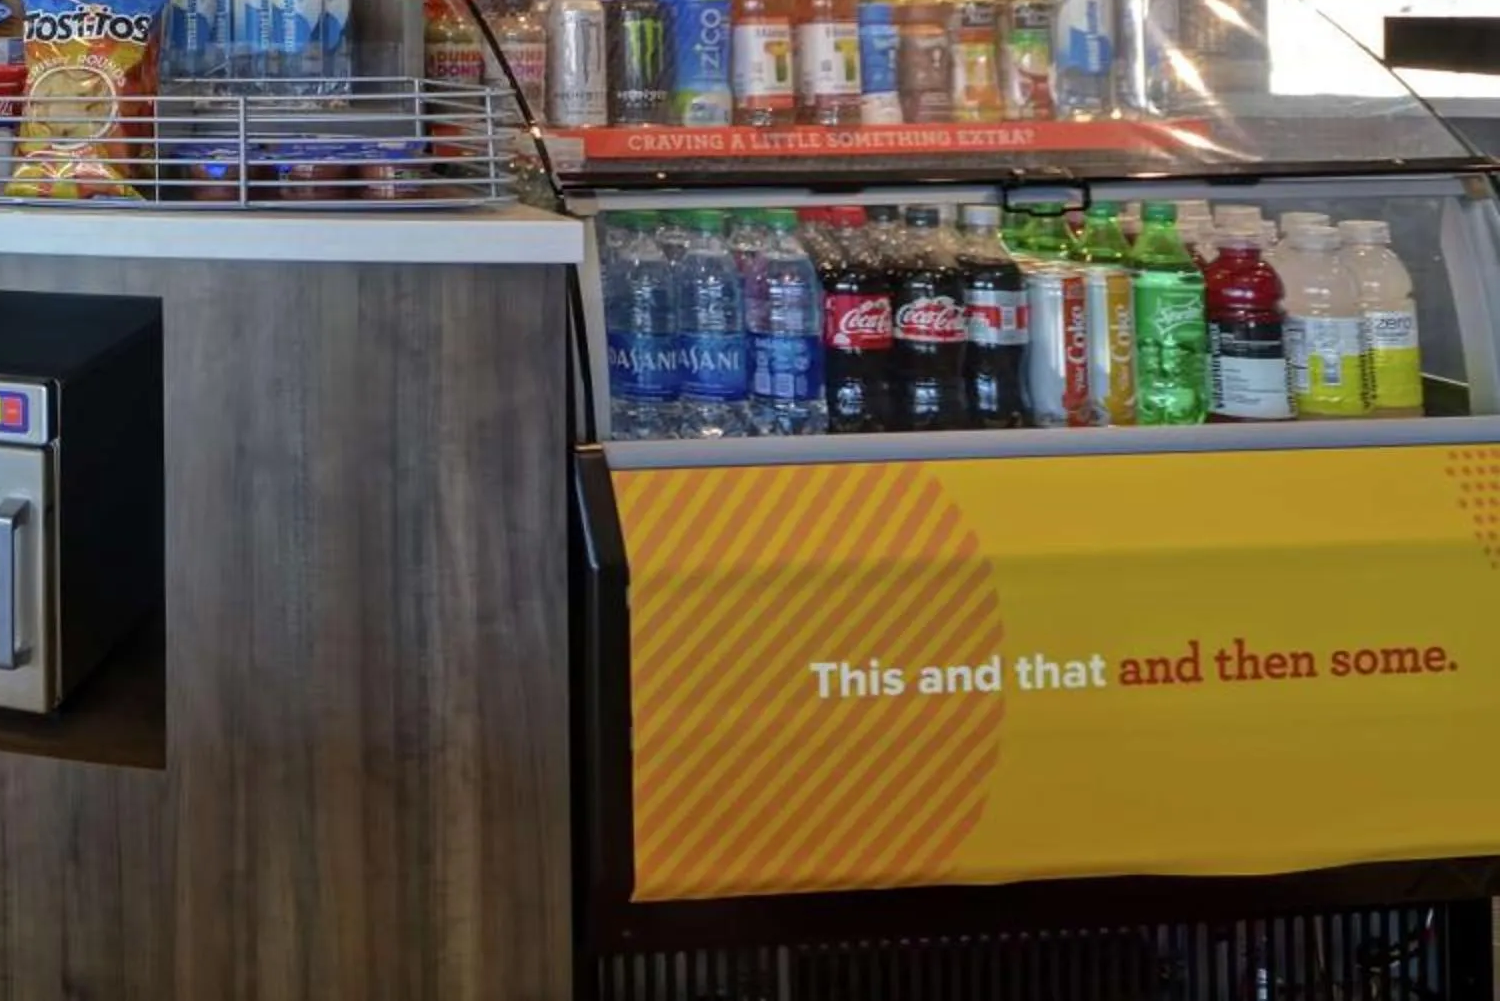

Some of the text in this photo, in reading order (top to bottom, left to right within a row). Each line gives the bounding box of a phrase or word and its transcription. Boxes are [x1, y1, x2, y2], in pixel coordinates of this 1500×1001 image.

[627, 128, 1035, 151] CRAVING A LITTLE SOMETHING EXTRA?
[608, 345, 677, 374] DASANI
[678, 345, 740, 374] ASANI
[809, 638, 1458, 699] This and that and then some.
